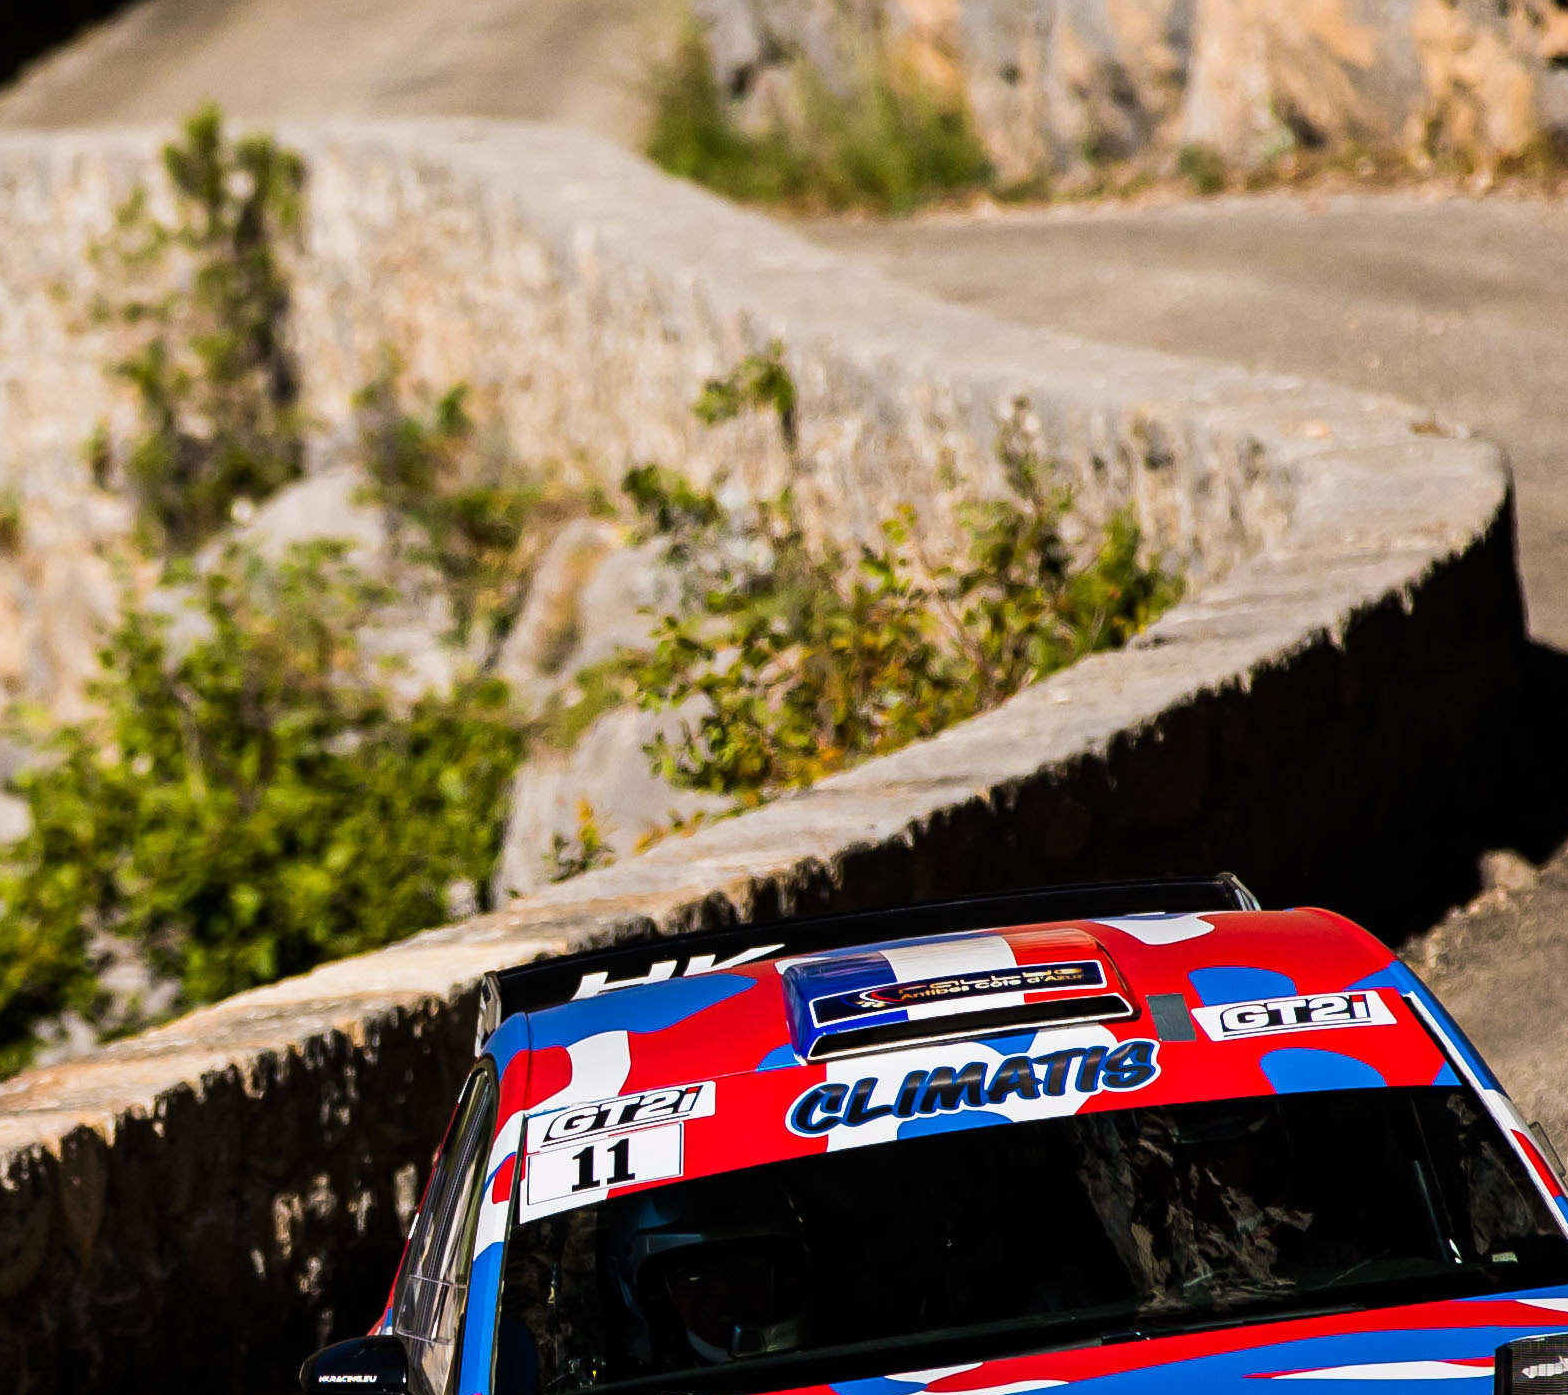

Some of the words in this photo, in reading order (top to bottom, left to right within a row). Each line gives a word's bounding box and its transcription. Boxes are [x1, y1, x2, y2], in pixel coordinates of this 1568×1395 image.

[1220, 994, 1371, 1032] GT2i
[543, 1085, 704, 1143] GT2i
[788, 1039, 1159, 1135] CLIMATIS
[571, 1138, 636, 1192] 11
[318, 1374, 377, 1383] HKRACING.EU
